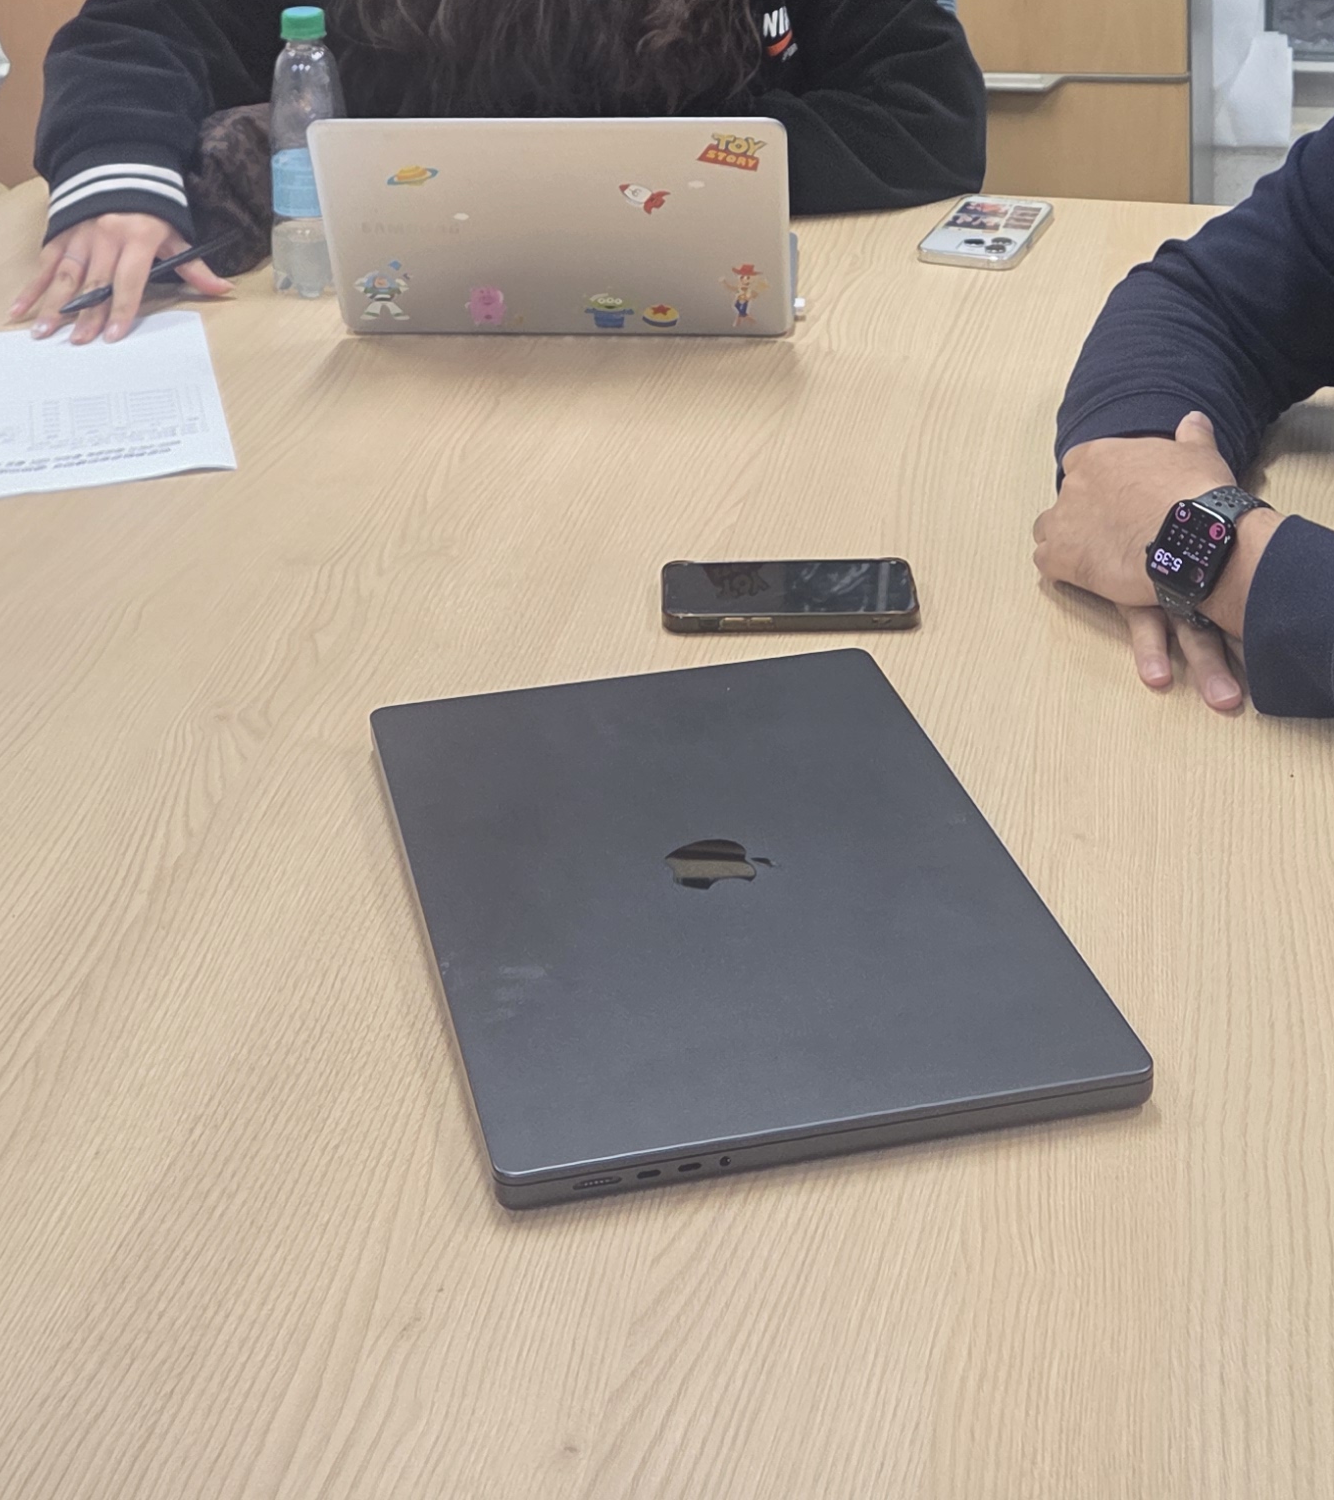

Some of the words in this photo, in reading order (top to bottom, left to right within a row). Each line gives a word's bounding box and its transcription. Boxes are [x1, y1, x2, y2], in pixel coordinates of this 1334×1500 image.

[711, 132, 767, 156] TOY
[706, 149, 757, 167] STORY
[1154, 548, 1183, 572] 5:39
